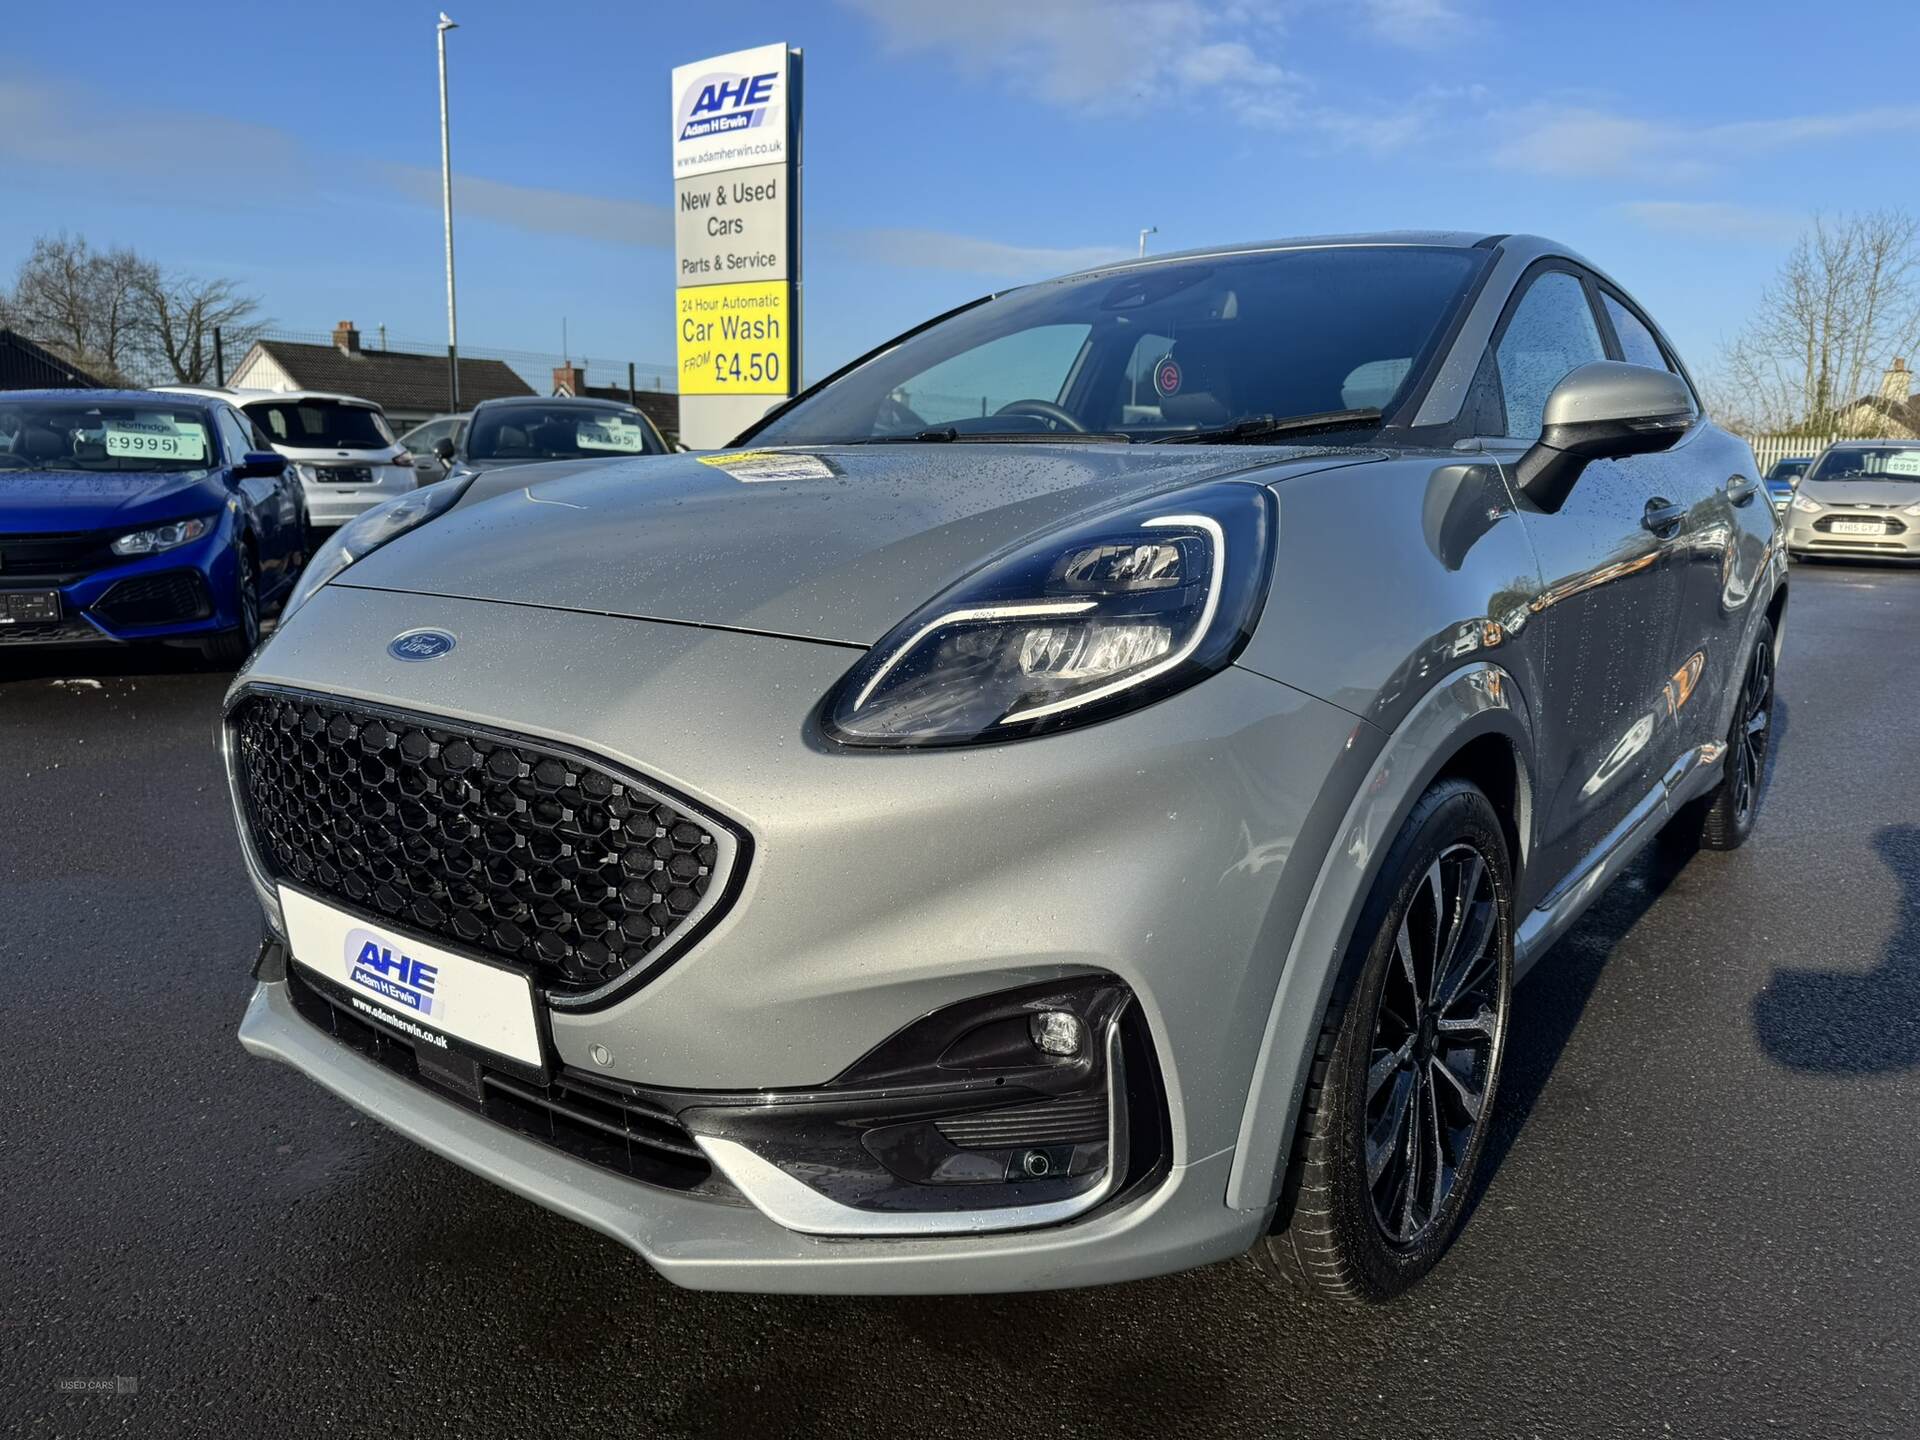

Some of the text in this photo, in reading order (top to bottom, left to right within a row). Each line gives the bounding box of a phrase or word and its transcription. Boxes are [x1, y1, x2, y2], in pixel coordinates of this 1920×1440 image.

[690, 71, 779, 117] AHE
[685, 115, 747, 137] Adam H Erwin
[677, 140, 782, 167] www.adamherwin.co.uk
[681, 178, 776, 212] New & Used
[707, 216, 743, 237] Cars
[682, 251, 776, 274] Parts & Service
[682, 294, 780, 312] 24 Hour Automatic
[682, 314, 780, 342] Car Wash
[683, 351, 780, 382] FROM £4.50
[400, 635, 441, 655] Ford
[356, 940, 439, 995] AHE
[355, 970, 417, 1006] Adam H Erwin
[352, 997, 448, 1049] www.adamherwin.co.uk
